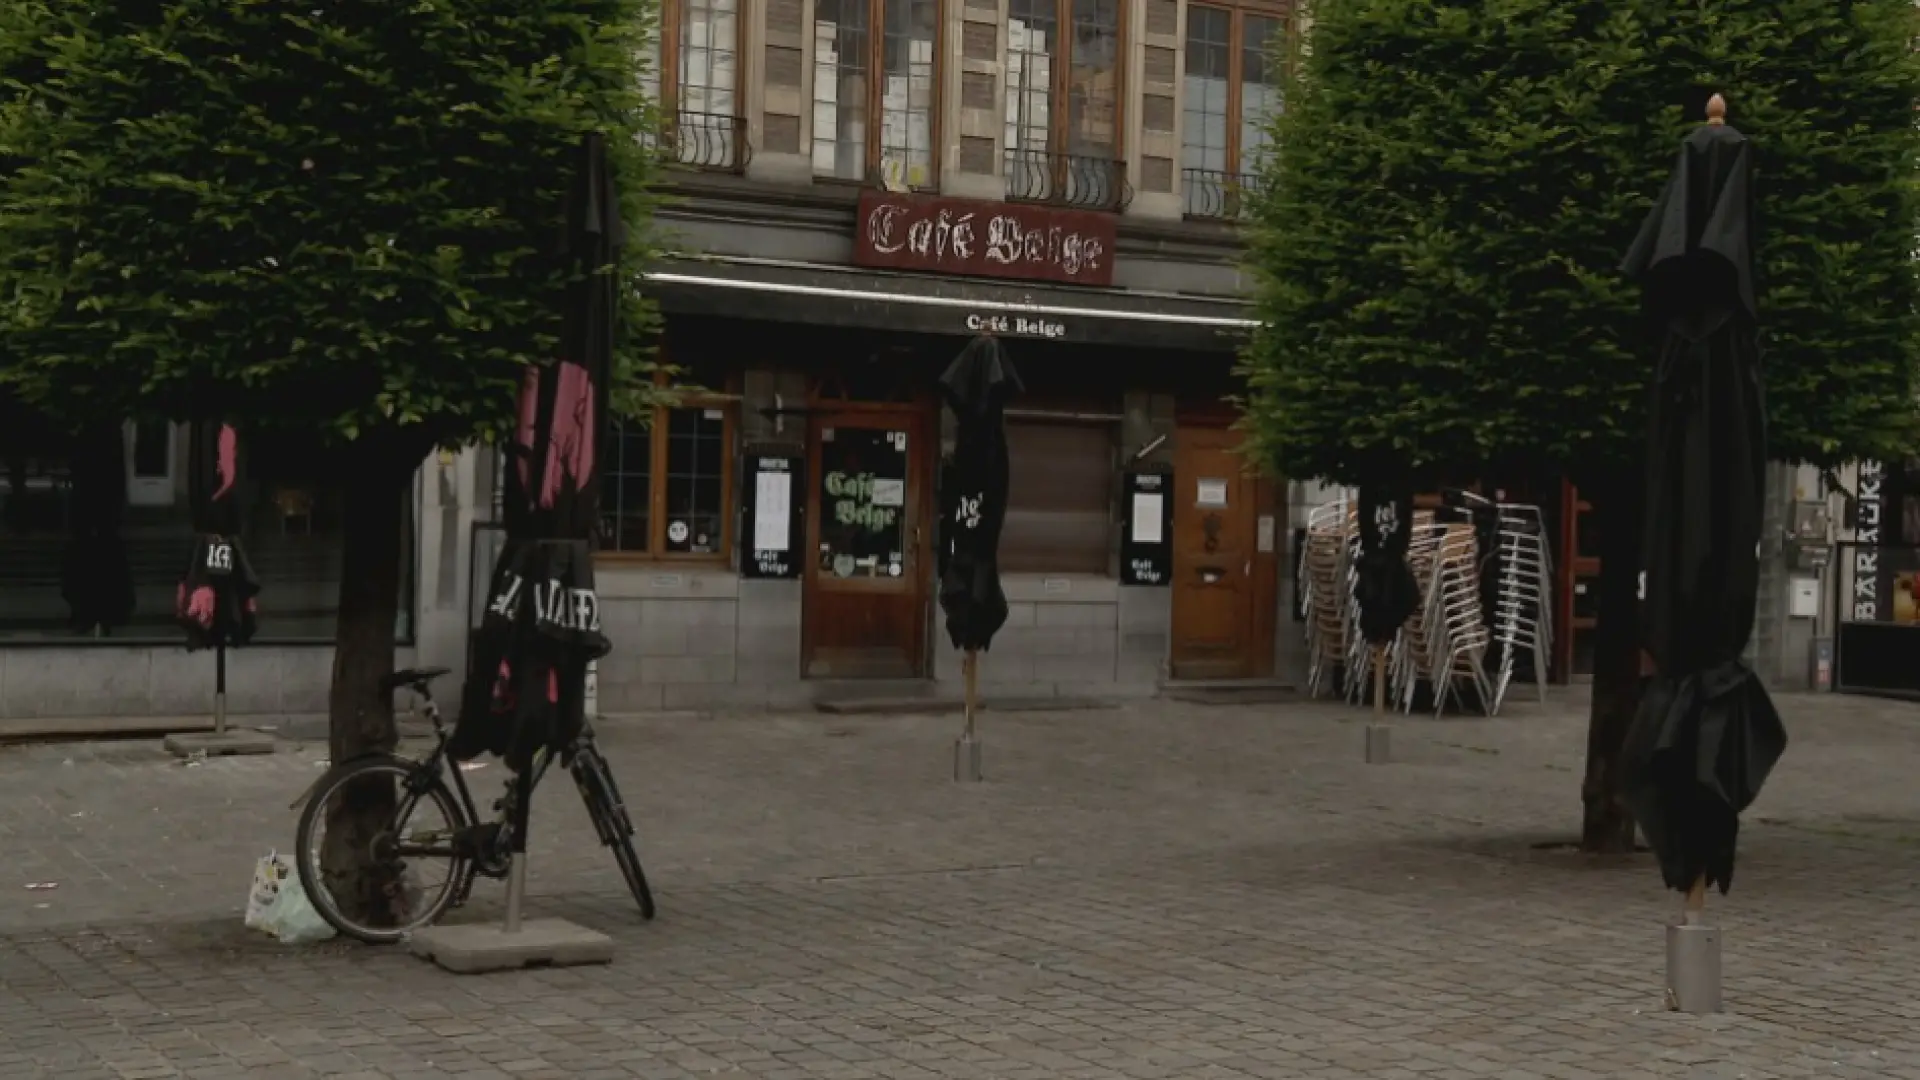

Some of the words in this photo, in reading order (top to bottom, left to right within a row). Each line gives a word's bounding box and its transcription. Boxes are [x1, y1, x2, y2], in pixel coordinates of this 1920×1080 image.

[867, 203, 977, 260] Café
[984, 214, 1103, 275] Belge
[1016, 317, 1067, 338] Belge
[836, 499, 896, 533] Belge
